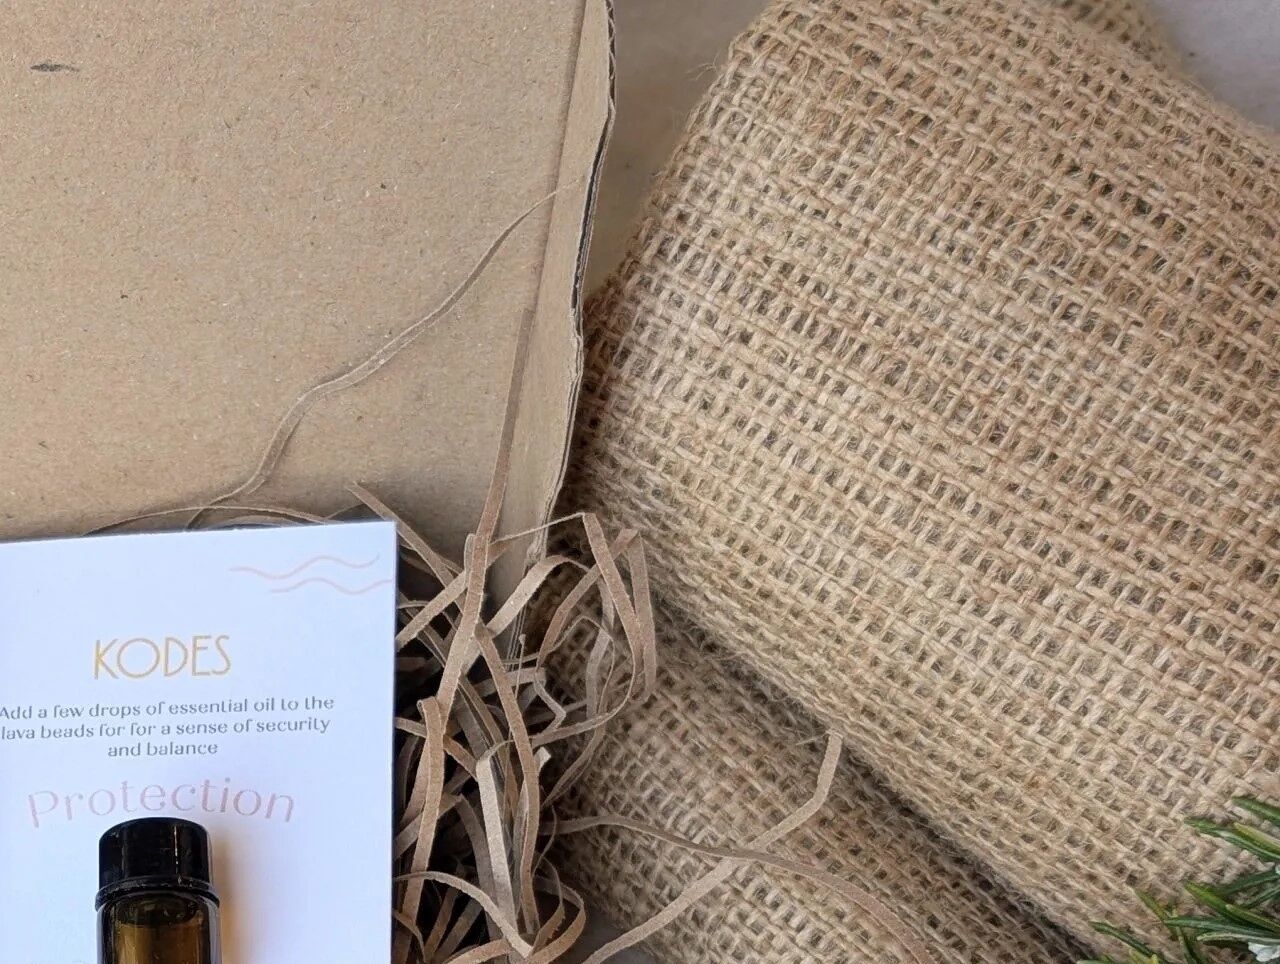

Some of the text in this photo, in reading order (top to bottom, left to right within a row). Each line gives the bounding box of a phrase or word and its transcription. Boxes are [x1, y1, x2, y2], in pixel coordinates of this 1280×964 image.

[93, 634, 232, 680] KODES
[38, 707, 48, 720] a
[54, 704, 84, 720] few
[89, 704, 141, 721] drops
[146, 701, 165, 716] of
[169, 699, 248, 716] essential
[254, 698, 275, 713] oil
[280, 698, 299, 711] to
[305, 696, 335, 711] the
[1, 717, 331, 740] lava beads for for a sense of security
[108, 741, 218, 758] and balance
[27, 776, 295, 829] Protection
